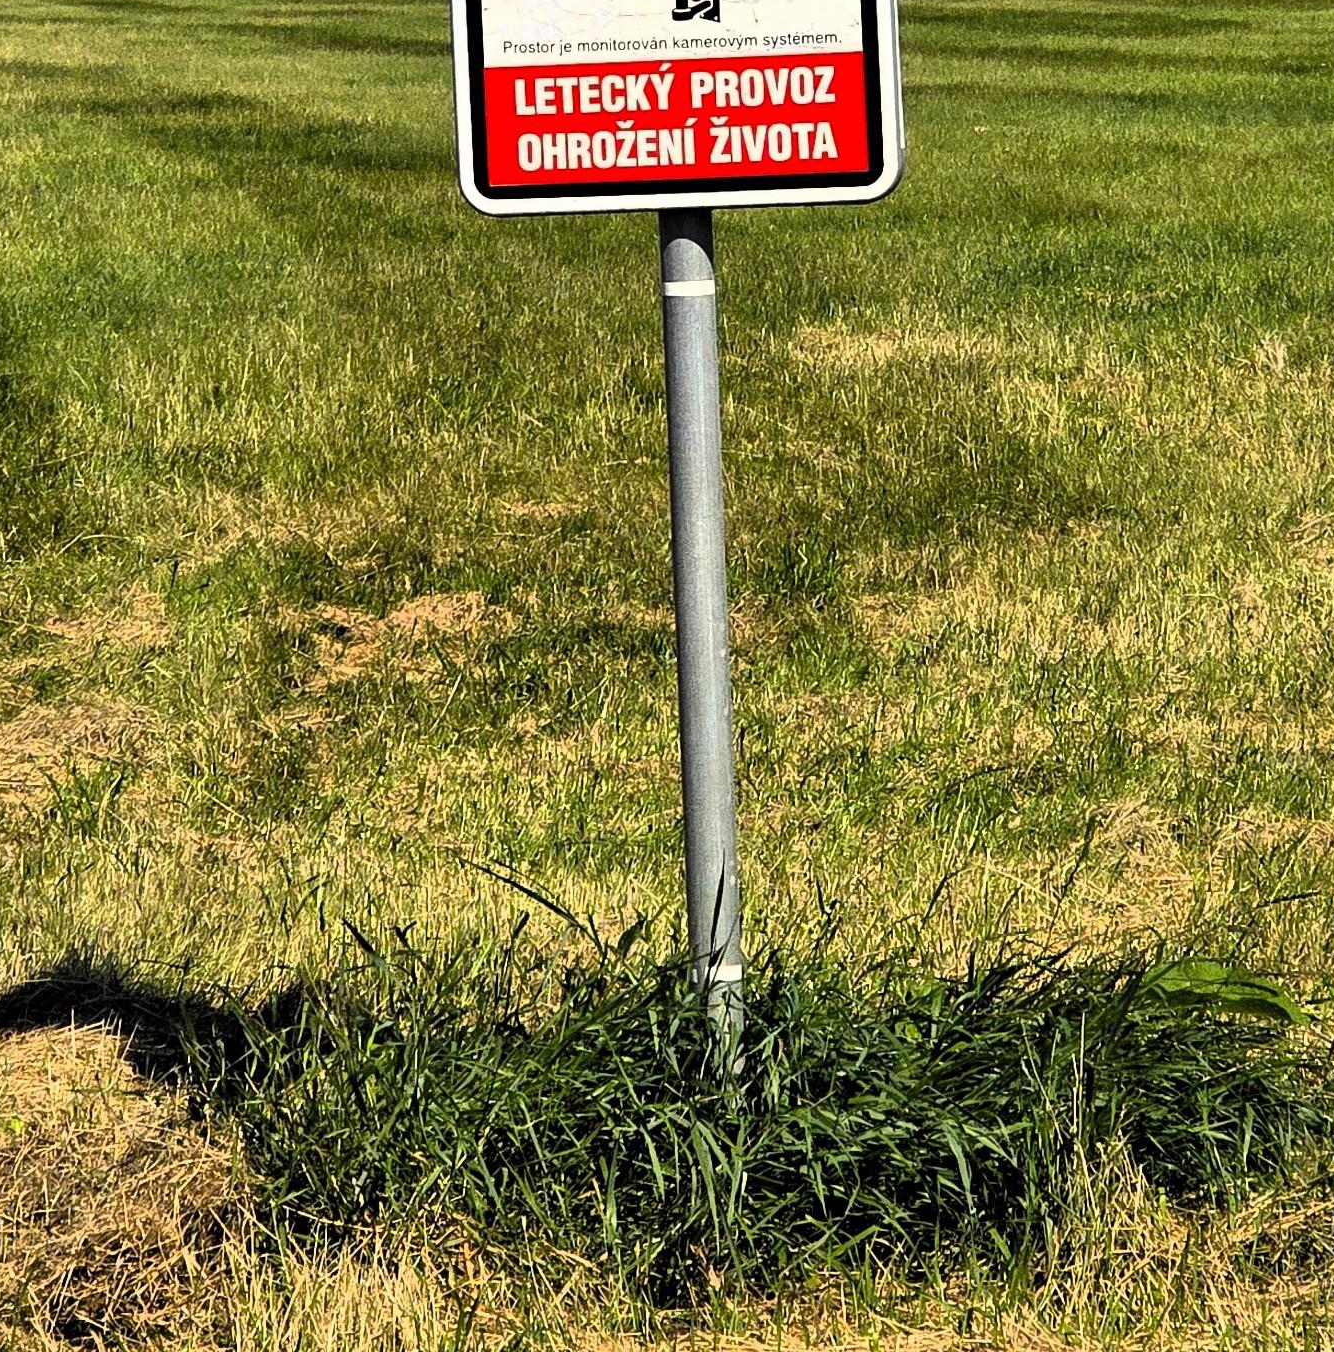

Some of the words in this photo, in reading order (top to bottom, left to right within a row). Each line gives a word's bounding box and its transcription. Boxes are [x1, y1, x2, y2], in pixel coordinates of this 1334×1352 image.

[503, 40, 556, 54] Prostor
[559, 39, 572, 57] je
[577, 36, 668, 52] monitorován
[672, 34, 758, 50] kamerovým
[762, 31, 843, 49] systémem.
[514, 63, 675, 116] LETECKÝ
[690, 65, 836, 109] PROVOZ
[517, 117, 698, 172] OHROŽENÍ
[709, 116, 838, 164] ŽIVOTA
